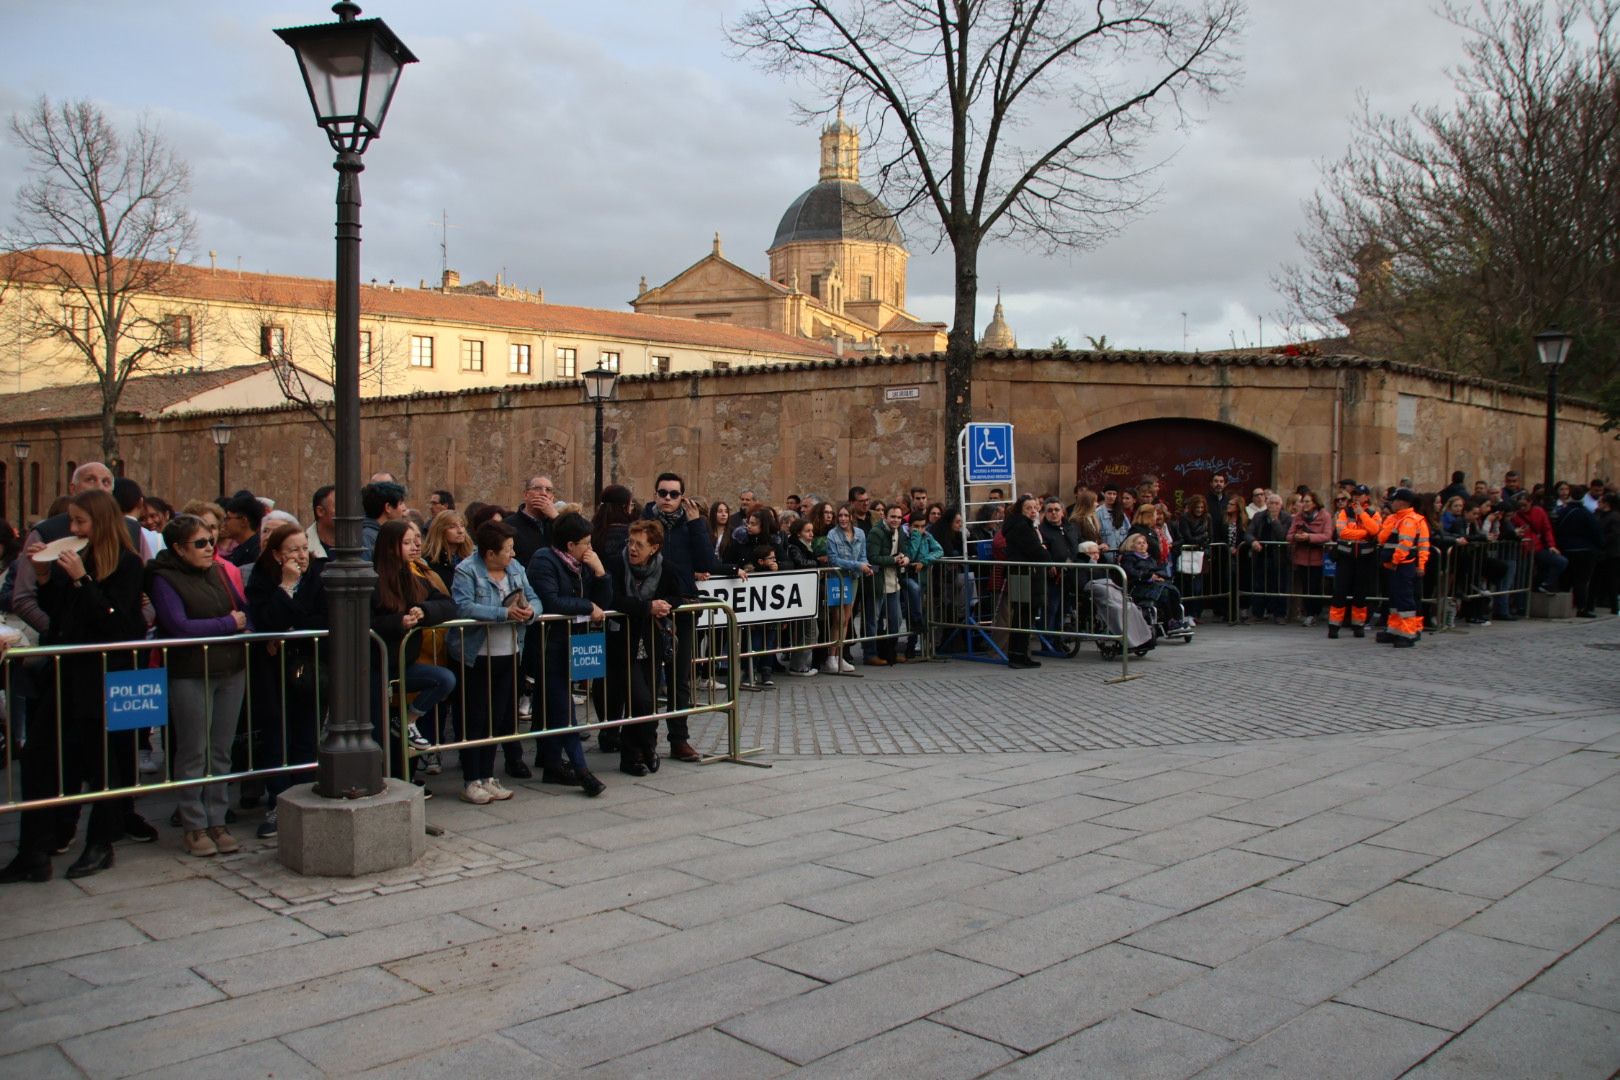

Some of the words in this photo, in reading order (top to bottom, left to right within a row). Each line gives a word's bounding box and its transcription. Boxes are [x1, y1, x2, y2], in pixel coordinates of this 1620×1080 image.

[572, 645, 603, 655] POLICIA
[574, 656, 601, 666] LOCAL
[110, 683, 162, 698] POLICIA
[113, 698, 159, 712] LOCAL
